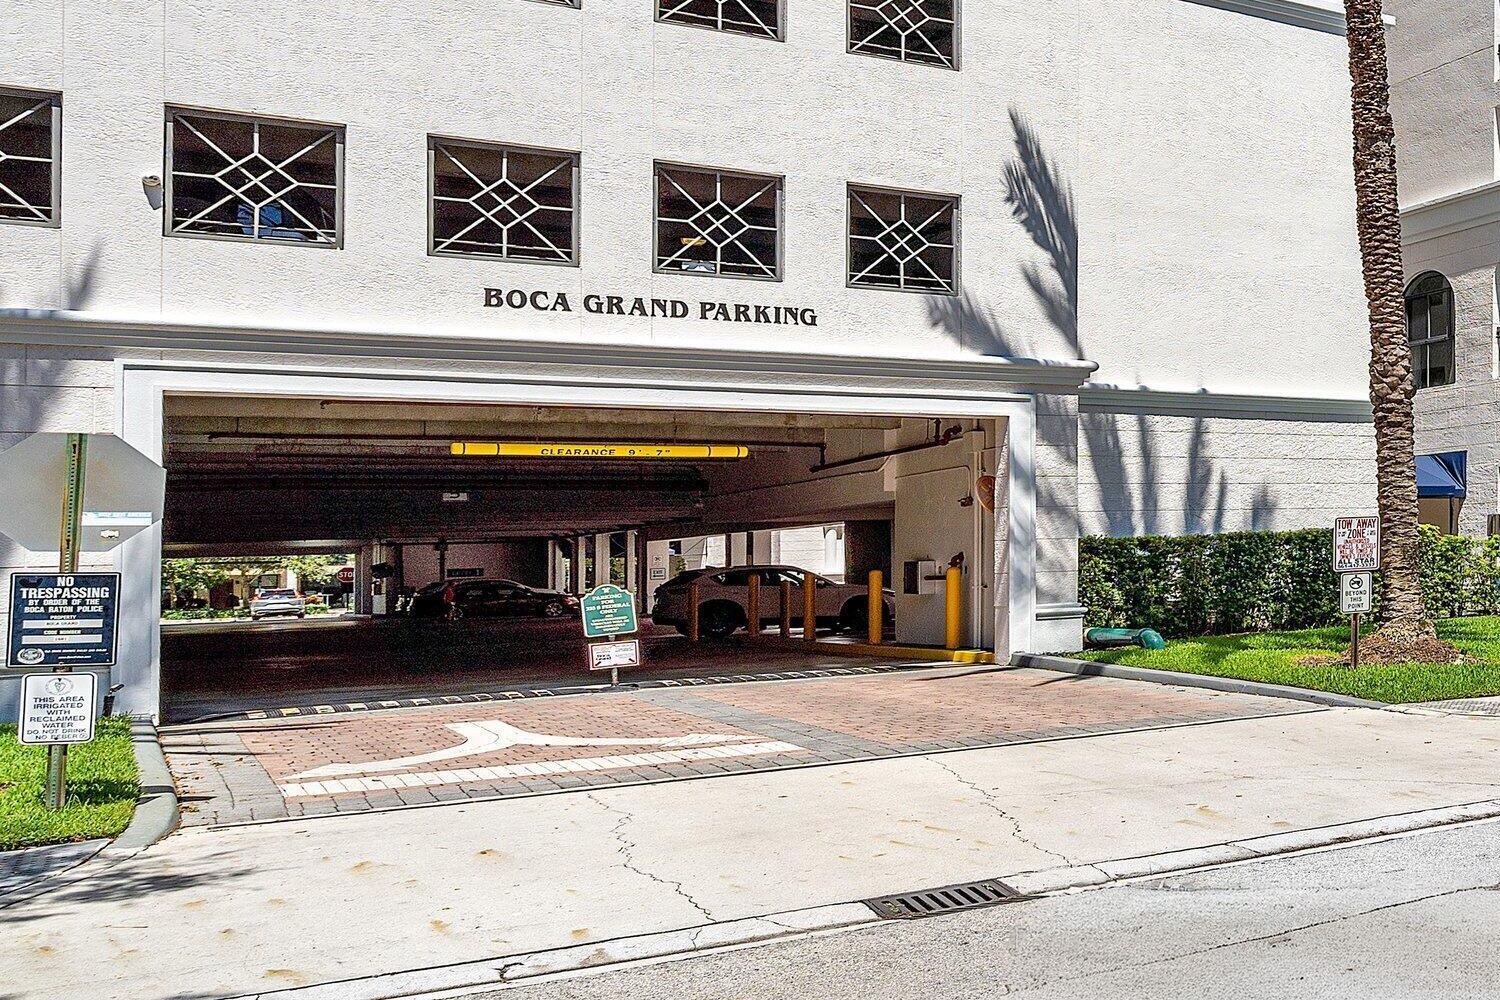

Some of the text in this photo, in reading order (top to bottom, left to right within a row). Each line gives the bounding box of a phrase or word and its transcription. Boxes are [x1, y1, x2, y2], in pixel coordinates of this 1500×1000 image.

[483, 288, 819, 327] BOCA GRAND PARKING
[541, 448, 616, 456] CLEARANCE
[1338, 518, 1376, 529] TOW AWAY
[1347, 529, 1365, 539] ZONE
[57, 576, 74, 587] NO
[20, 587, 110, 599] TRESPASSING
